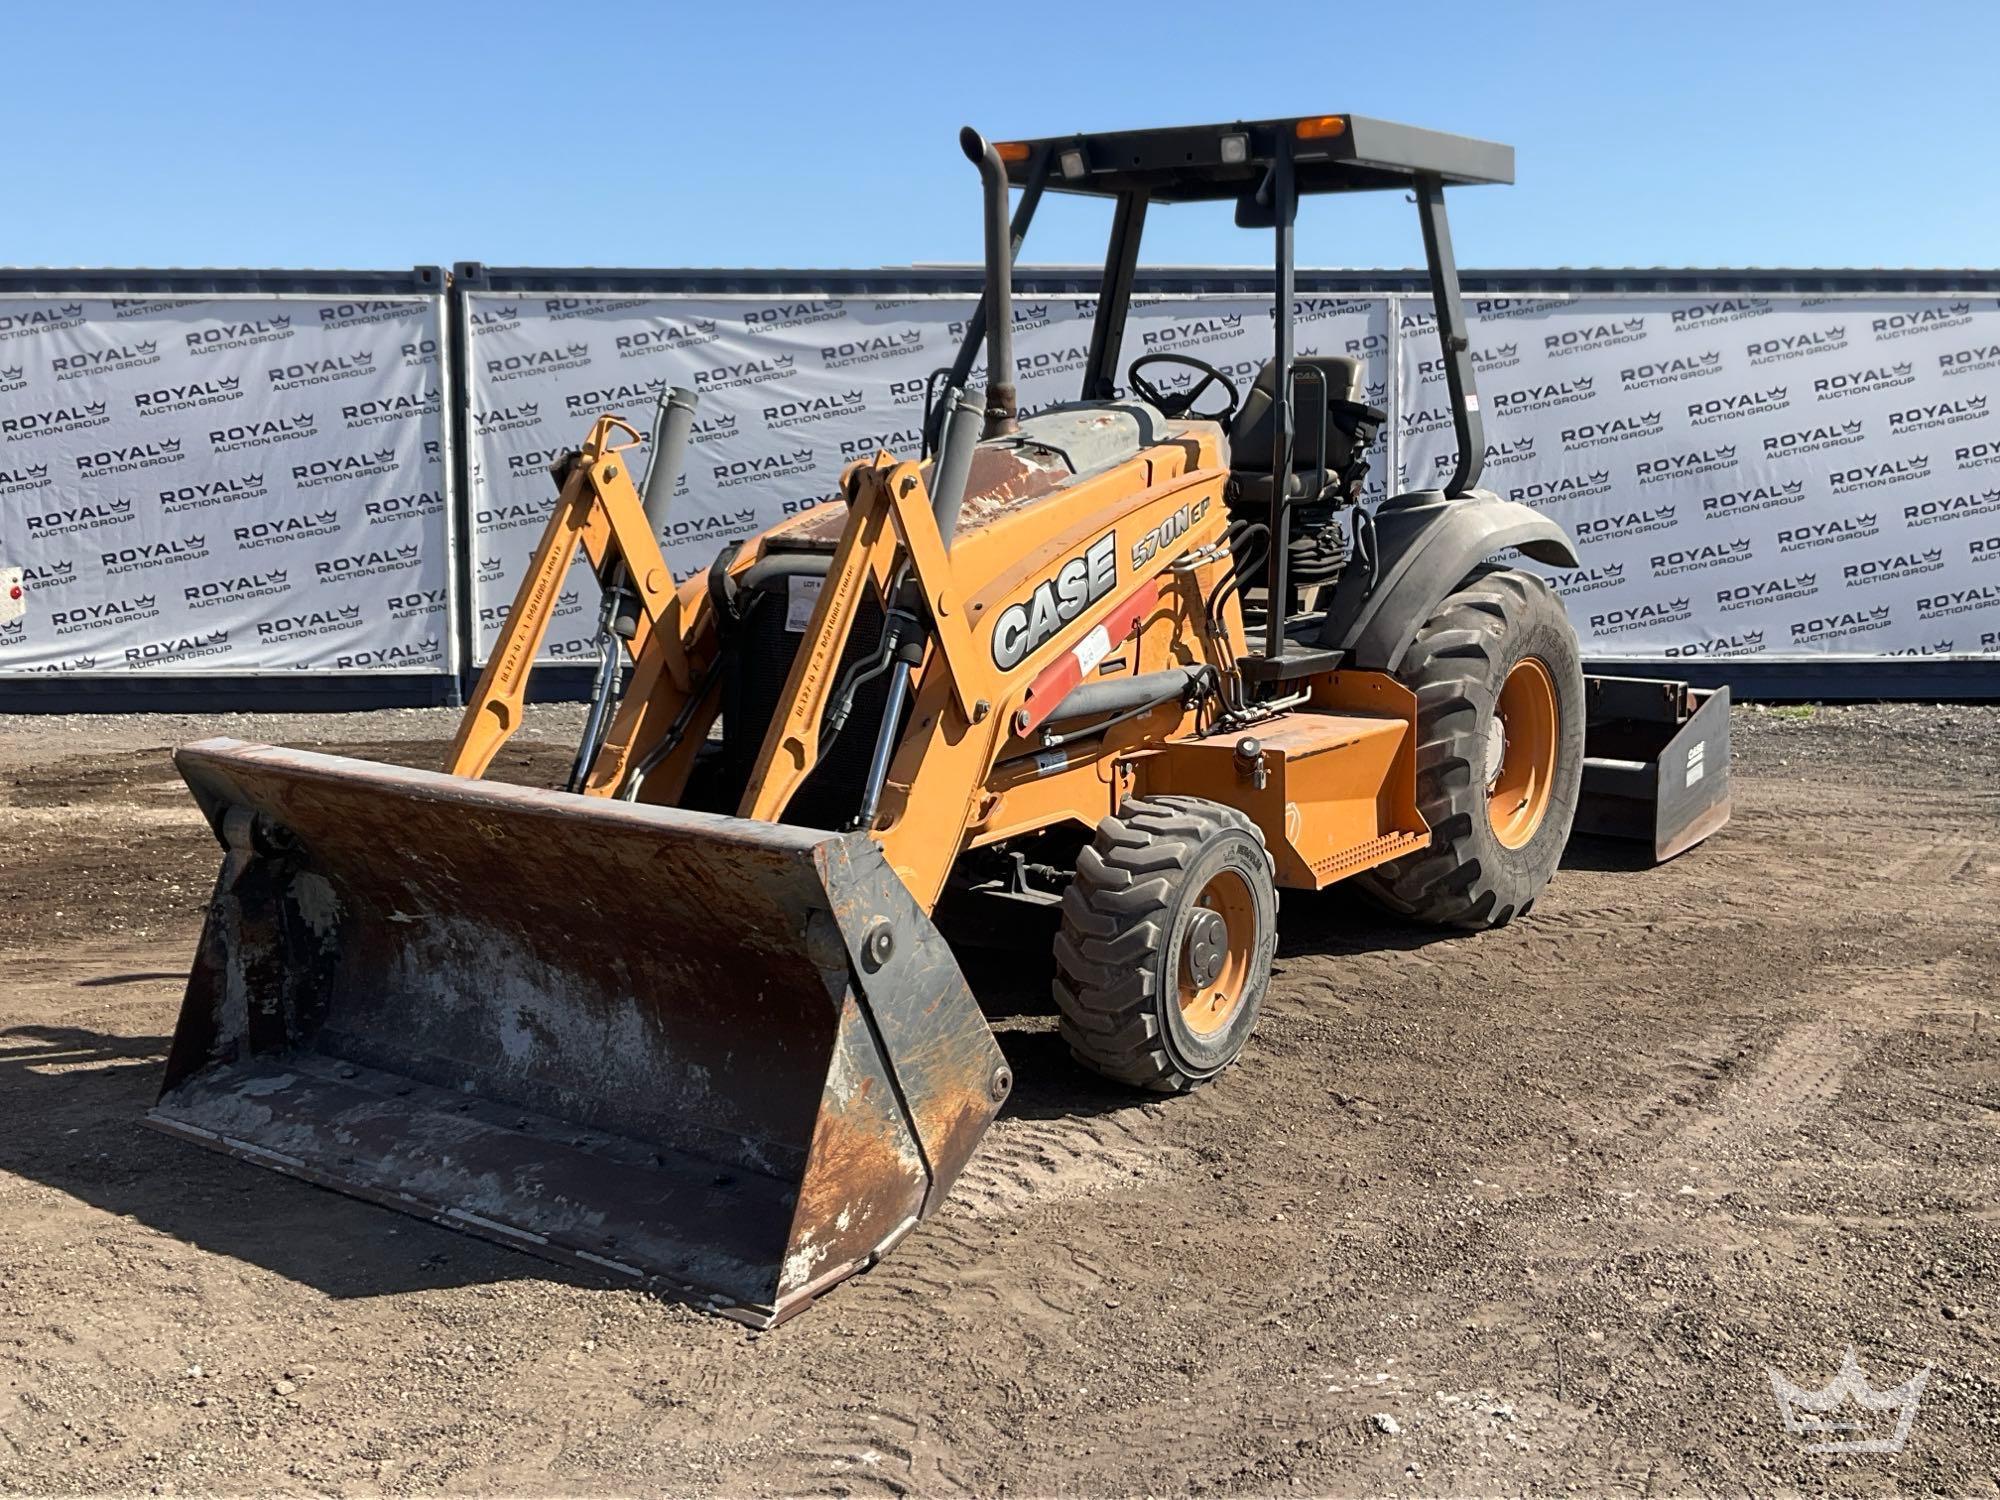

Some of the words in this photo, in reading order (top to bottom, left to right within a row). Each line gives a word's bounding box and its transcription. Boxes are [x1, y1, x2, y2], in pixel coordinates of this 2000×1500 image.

[745, 303, 824, 324] ROYAL
[748, 319, 802, 334] AUCTION
[804, 310, 847, 324] GROUP
[1672, 300, 1751, 323] ROYAL
[1872, 308, 1950, 332] ROYAL
[185, 321, 269, 346] ROYAL
[615, 326, 696, 349] ROYAL
[1142, 321, 1222, 345] ROYAL
[1146, 338, 1199, 353] AUCTION
[1202, 329, 1244, 342] GROUP
[1544, 324, 1624, 349] ROYAL
[1747, 333, 1825, 357] ROYAL
[619, 343, 674, 358] AUCTION
[676, 334, 720, 348] GROUP
[821, 335, 900, 360] ROYAL
[1548, 342, 1601, 358] AUCTION
[1604, 333, 1646, 346] GROUP
[53, 346, 136, 371] ROYAL
[269, 357, 352, 382] ROYAL
[487, 349, 568, 373] ROYAL
[491, 367, 546, 382] AUCTION
[549, 358, 593, 372] GROUP
[825, 354, 879, 371] AUCTION
[881, 345, 924, 359] GROUP
[1478, 359, 1520, 372] GROUP
[1620, 358, 1700, 382] ROYAL
[274, 376, 330, 393] AUCTION
[332, 366, 377, 381] GROUP
[694, 360, 774, 384] ROYAL
[698, 378, 752, 394] AUCTION
[754, 369, 797, 383] GROUP
[1020, 364, 1074, 379] AUCTION
[1624, 375, 1677, 390] AUCTION
[1680, 366, 1722, 379] GROUP
[1814, 368, 1892, 392] ROYAL
[136, 382, 219, 407] ROYAL
[566, 384, 646, 408] ROYAL
[1494, 383, 1573, 408] ROYAL
[1817, 385, 1870, 400] AUCTION
[1872, 376, 1914, 389] GROUP
[140, 401, 196, 418] AUCTION
[199, 391, 244, 406] GROUP
[342, 394, 425, 419] ROYAL
[570, 402, 624, 418] AUCTION
[763, 396, 842, 420] ROYAL
[1496, 401, 1550, 417] AUCTION
[1552, 392, 1595, 406] GROUP
[1688, 393, 1768, 417] ROYAL
[1692, 410, 1745, 425] AUCTION
[1748, 401, 1790, 414] GROUP
[1889, 402, 1967, 426] ROYAL
[2, 408, 85, 432] ROYAL
[6, 426, 62, 442] AUCTION
[65, 416, 110, 431] GROUP
[346, 413, 402, 430] AUCTION
[767, 414, 821, 430] AUCTION
[823, 405, 866, 419] GROUP
[1892, 419, 1945, 434] AUCTION
[1947, 410, 1989, 423] GROUP
[210, 420, 293, 444] ROYAL
[214, 438, 270, 454] AUCTION
[273, 428, 318, 443] GROUP
[840, 430, 920, 454] ROYAL
[1562, 418, 1641, 443] ROYAL
[1564, 436, 1618, 452] AUCTION
[1620, 427, 1663, 440] GROUP
[1764, 426, 1843, 451] ROYAL
[77, 444, 160, 469] ROYAL
[1766, 444, 1820, 460] AUCTION
[1822, 435, 1865, 448] GROUP
[82, 463, 138, 479] AUCTION
[140, 454, 185, 468] GROUP
[292, 454, 375, 479] ROYAL
[713, 455, 792, 478] ROYAL
[717, 472, 771, 487] AUCTION
[773, 463, 816, 477] GROUP
[1636, 451, 1716, 476] ROYAL
[1640, 469, 1693, 485] AUCTION
[1696, 460, 1738, 474] GROUP
[1830, 461, 1909, 486] ROYAL
[296, 473, 352, 489] AUCTION
[355, 464, 400, 478] GROUP
[1832, 479, 1886, 495] AUCTION
[1888, 470, 1931, 484] GROUP
[160, 480, 243, 504] ROYAL
[164, 498, 220, 514] AUCTION
[223, 488, 268, 503] GROUP
[1510, 476, 1589, 502] ROYAL
[1568, 486, 1611, 500] GROUP
[1704, 486, 1783, 511] ROYAL
[27, 505, 110, 530] ROYAL
[1706, 504, 1760, 520] AUCTION
[1762, 495, 1805, 508] GROUP
[1904, 495, 1982, 519] ROYAL
[32, 524, 88, 541] AUCTION
[90, 514, 135, 529] GROUP
[234, 516, 317, 540] ROYAL
[1576, 511, 1656, 536] ROYAL
[1778, 520, 1857, 544] ROYAL
[1907, 512, 1960, 528] AUCTION
[238, 534, 294, 549] AUCTION
[297, 525, 342, 539] GROUP
[660, 532, 713, 547] AUCTION
[716, 523, 758, 536] GROUP
[1580, 529, 1633, 545] AUCTION
[1636, 520, 1678, 534] GROUP
[1780, 537, 1834, 552] AUCTION
[1836, 528, 1879, 541] GROUP
[102, 541, 185, 566] ROYAL
[106, 560, 162, 577] AUCTION
[165, 550, 210, 565] GROUP
[316, 550, 397, 574] ROYAL
[1650, 545, 1730, 569] ROYAL
[1654, 562, 1707, 577] AUCTION
[1710, 553, 1752, 566] GROUP
[320, 568, 375, 583] AUCTION
[378, 559, 422, 573] GROUP
[1844, 554, 1923, 579] ROYAL
[1846, 572, 1900, 588] AUCTION
[1902, 563, 1945, 576] GROUP
[184, 576, 267, 600] ROYAL
[188, 594, 244, 610] AUCTION
[247, 584, 292, 599] GROUP
[1582, 578, 1625, 592] GROUP
[1716, 579, 1796, 604] ROYAL
[52, 600, 135, 625] ROYAL
[992, 530, 1116, 671] CASE
[1720, 597, 1773, 613] AUCTION
[1776, 588, 1818, 602] GROUP
[56, 619, 112, 635] AUCTION
[115, 610, 160, 624] GROUP
[258, 611, 339, 635] ROYAL
[320, 620, 364, 634] GROUP
[1590, 604, 1670, 628] ROYAL
[1594, 621, 1647, 636] AUCTION
[1650, 612, 1692, 625] GROUP
[1791, 612, 1869, 636] ROYAL
[1794, 629, 1847, 644] AUCTION
[1849, 620, 1891, 633] GROUP
[125, 636, 208, 660] ROYAL
